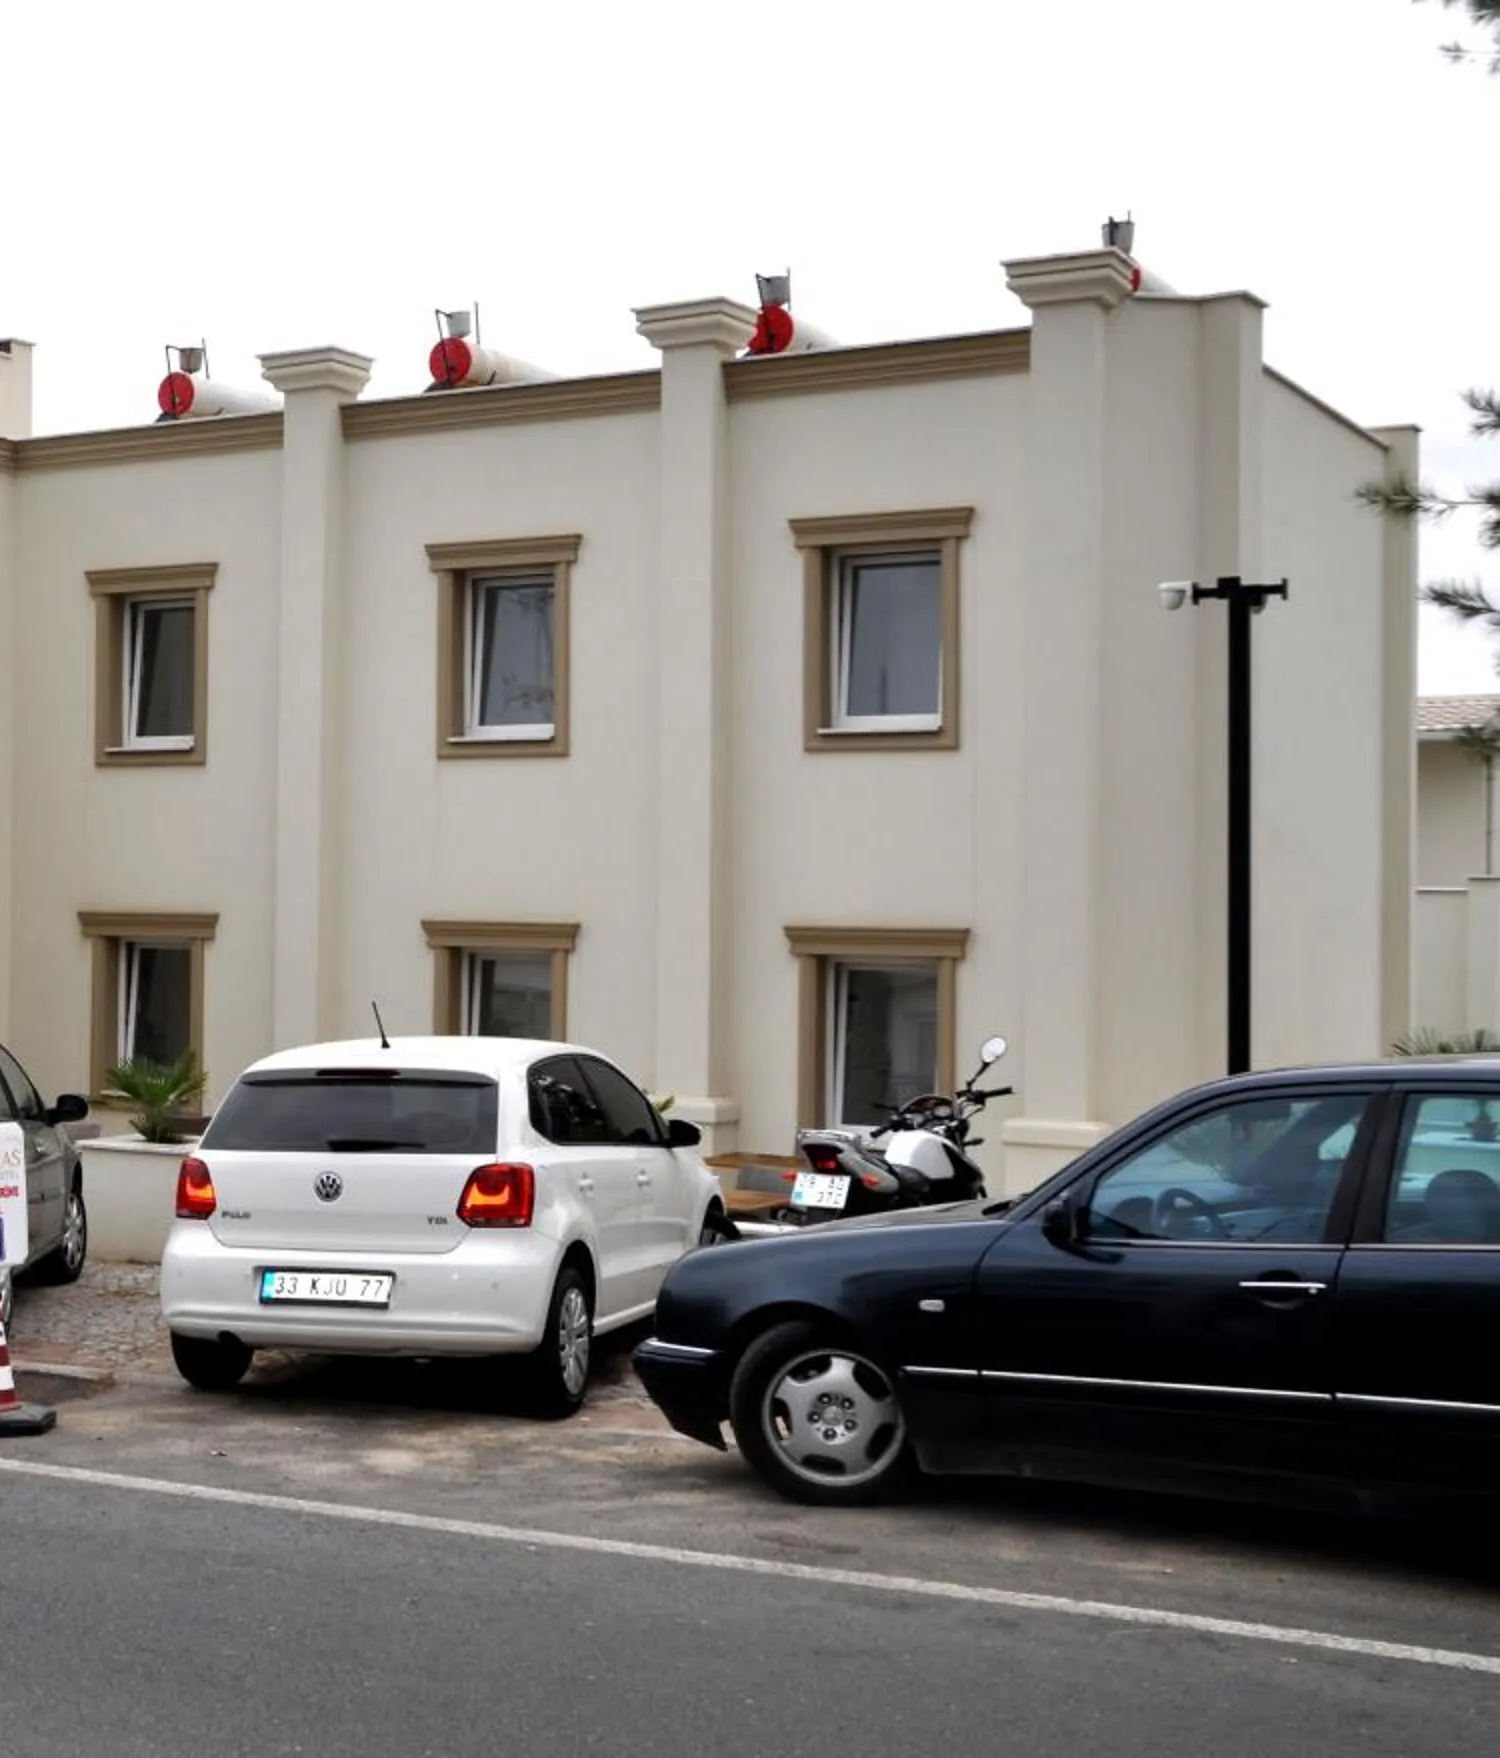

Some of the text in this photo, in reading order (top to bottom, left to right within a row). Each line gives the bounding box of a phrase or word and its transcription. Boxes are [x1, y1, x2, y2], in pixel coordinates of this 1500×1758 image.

[275, 1277, 384, 1298] 33 KJU 77
